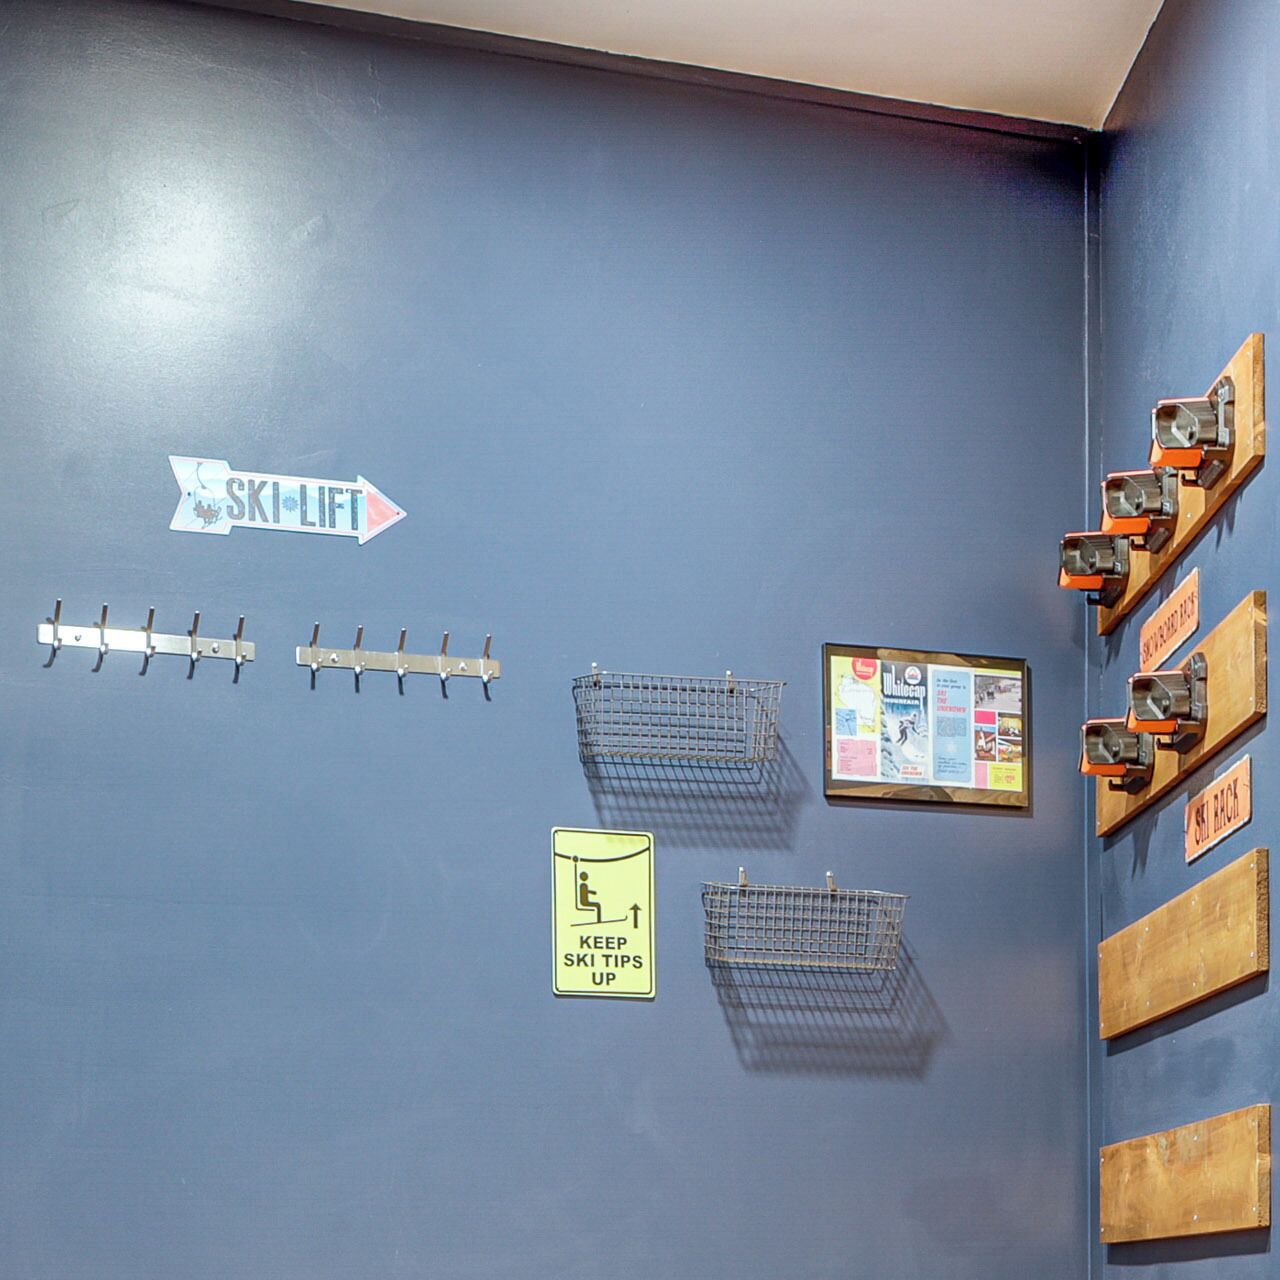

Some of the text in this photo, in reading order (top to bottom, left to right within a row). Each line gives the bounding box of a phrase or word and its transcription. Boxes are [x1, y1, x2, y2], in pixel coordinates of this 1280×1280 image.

[225, 477, 363, 531] SKI LIFT
[883, 665, 926, 700] Whitecap
[1194, 777, 1240, 846] SKI RACK
[580, 936, 628, 950] KEEP
[564, 953, 644, 969] SKI TIPS
[592, 972, 617, 986] UP
